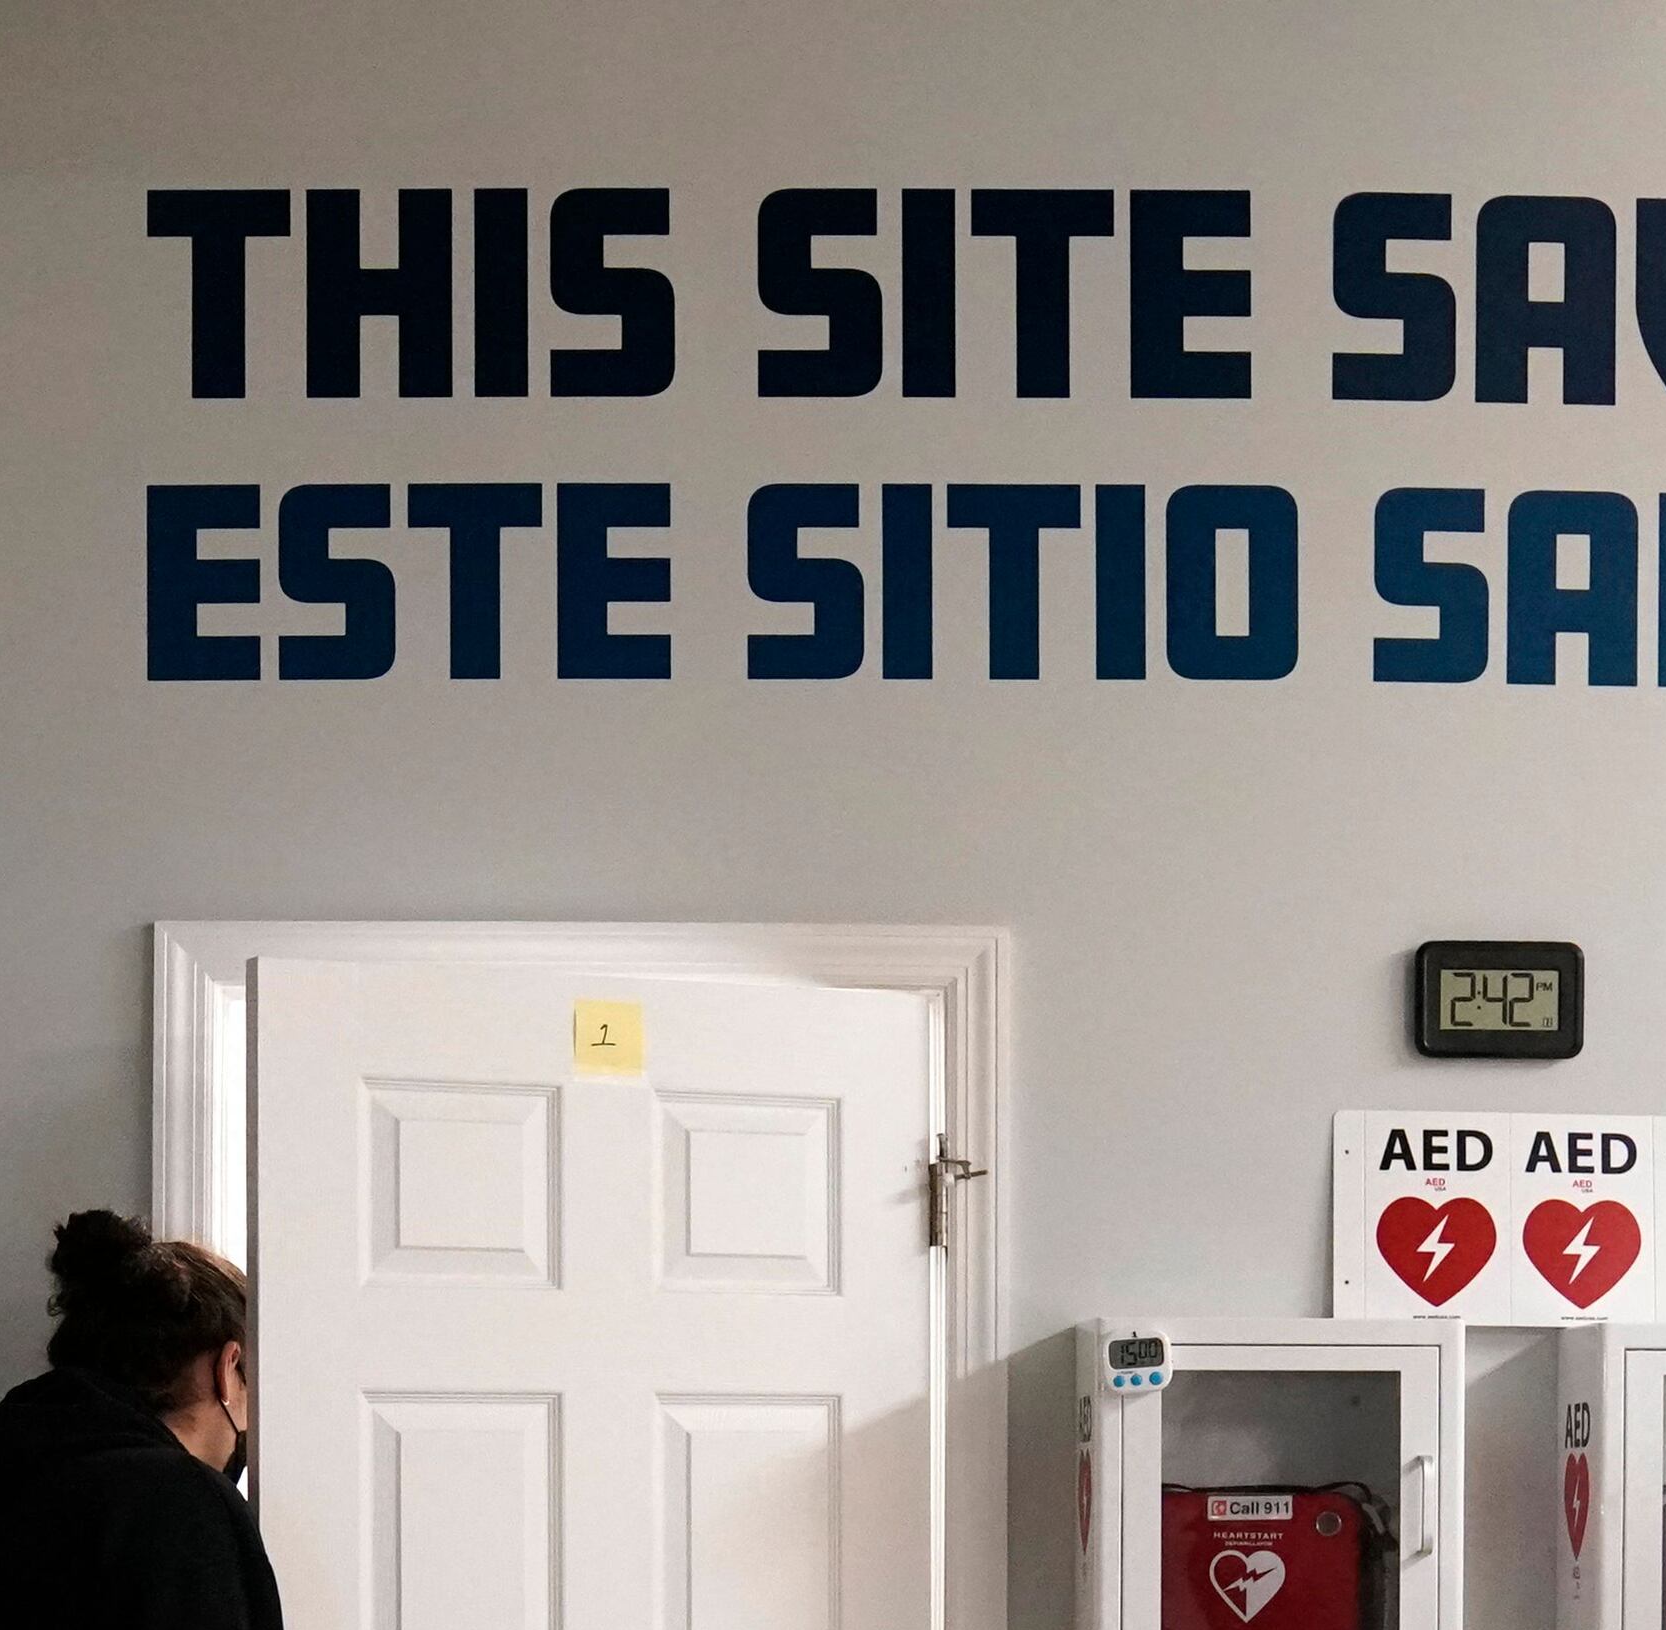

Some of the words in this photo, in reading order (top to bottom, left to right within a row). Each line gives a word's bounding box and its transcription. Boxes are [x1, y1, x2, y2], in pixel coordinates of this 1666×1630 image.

[147, 188, 675, 398] THIS
[758, 188, 1251, 399] SITE
[147, 483, 671, 681] ESTE
[747, 483, 1298, 680] SITIO
[1450, 972, 1534, 1027] 2:42
[1535, 982, 1553, 992] PM
[590, 1023, 616, 1046] 1
[1379, 1128, 1493, 1172] AED
[1525, 1131, 1637, 1174] AED
[1425, 1178, 1446, 1187] AED
[1572, 1180, 1593, 1189] AED
[1565, 1402, 1591, 1448] AED
[1230, 1502, 1259, 1515] Call
[1264, 1502, 1289, 1514] 911
[1213, 1531, 1284, 1540] HEARTSTART
